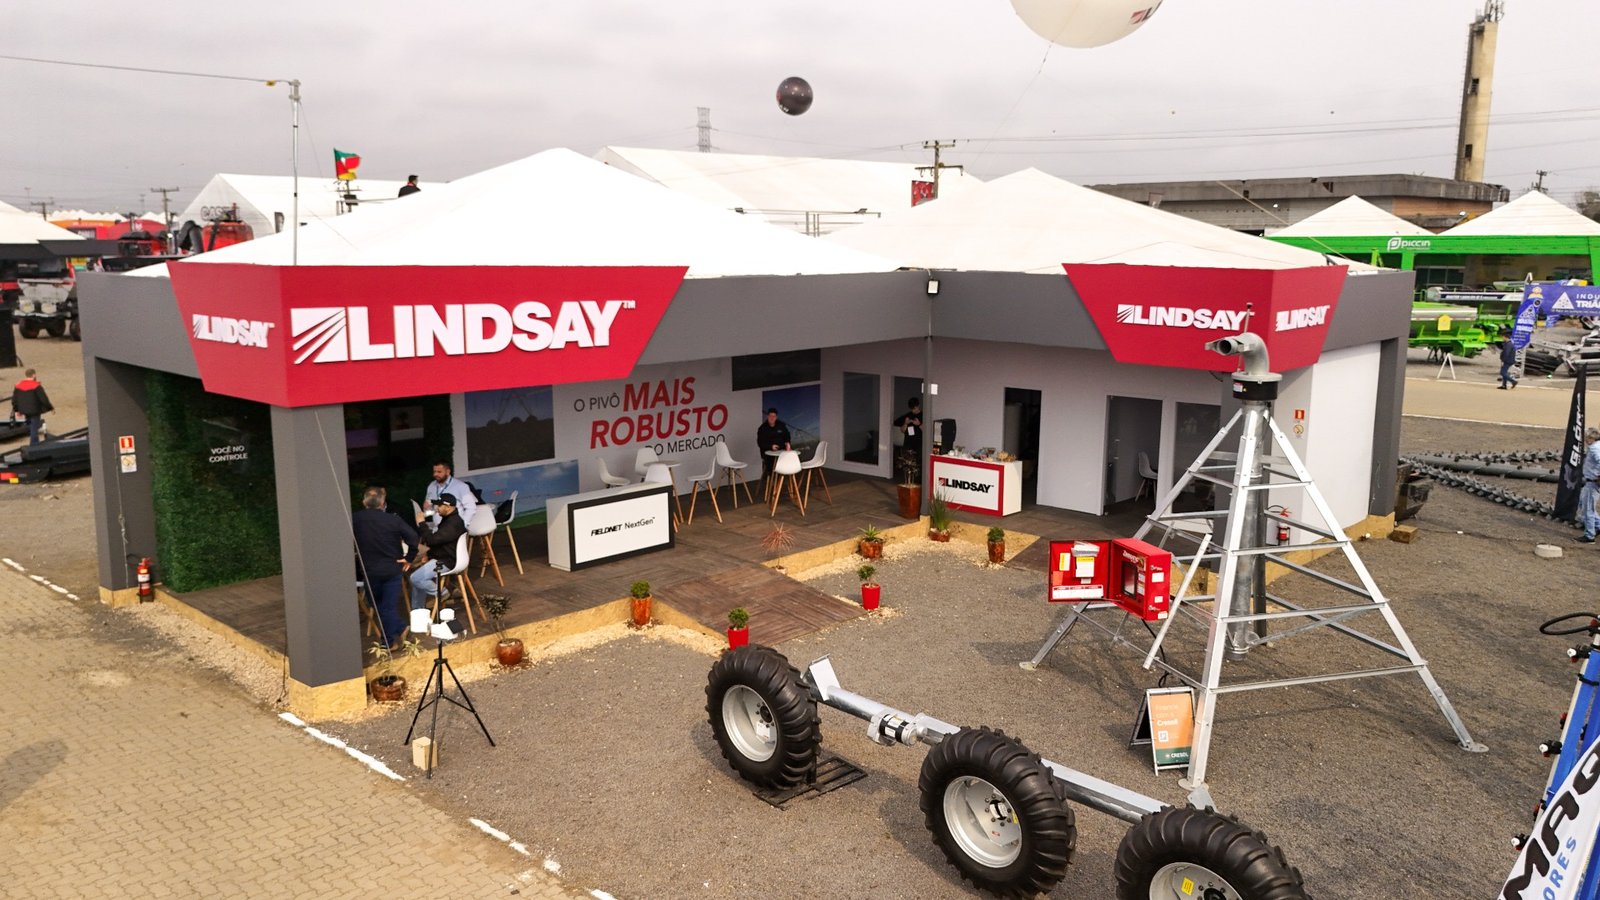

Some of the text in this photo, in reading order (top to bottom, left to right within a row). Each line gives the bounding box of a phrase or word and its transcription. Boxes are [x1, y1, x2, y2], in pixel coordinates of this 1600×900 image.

[200, 206, 229, 221] CAS
[573, 376, 696, 413] O PIVÔ MAIS
[590, 403, 729, 450] ROBUSTO
[210, 445, 245, 455] VOCÊ NO
[645, 443, 664, 456] O
[208, 453, 249, 463] CONTROLE
[590, 524, 623, 537] FIELDNET
